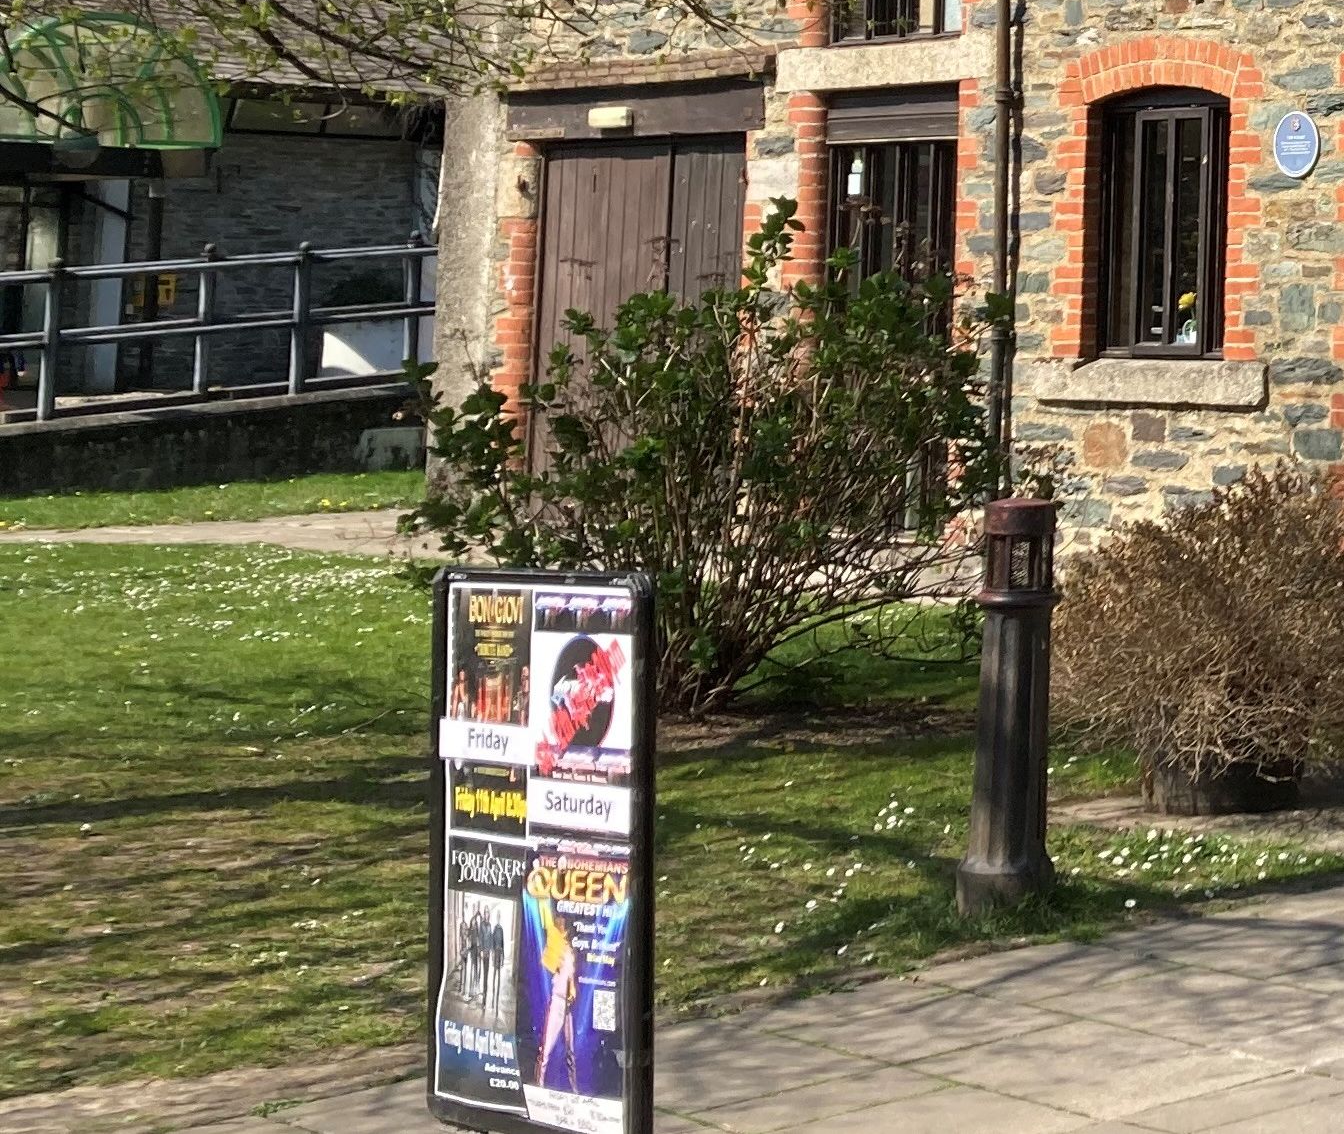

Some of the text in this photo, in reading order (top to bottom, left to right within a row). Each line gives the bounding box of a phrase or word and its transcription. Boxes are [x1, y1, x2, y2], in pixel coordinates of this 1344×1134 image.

[468, 728, 509, 756] Friday
[545, 790, 613, 823] Saturday
[539, 855, 557, 868] THE
[458, 865, 515, 888] JOURNEY
[527, 866, 627, 905] QUEEN
[557, 900, 602, 916] GREATEST
